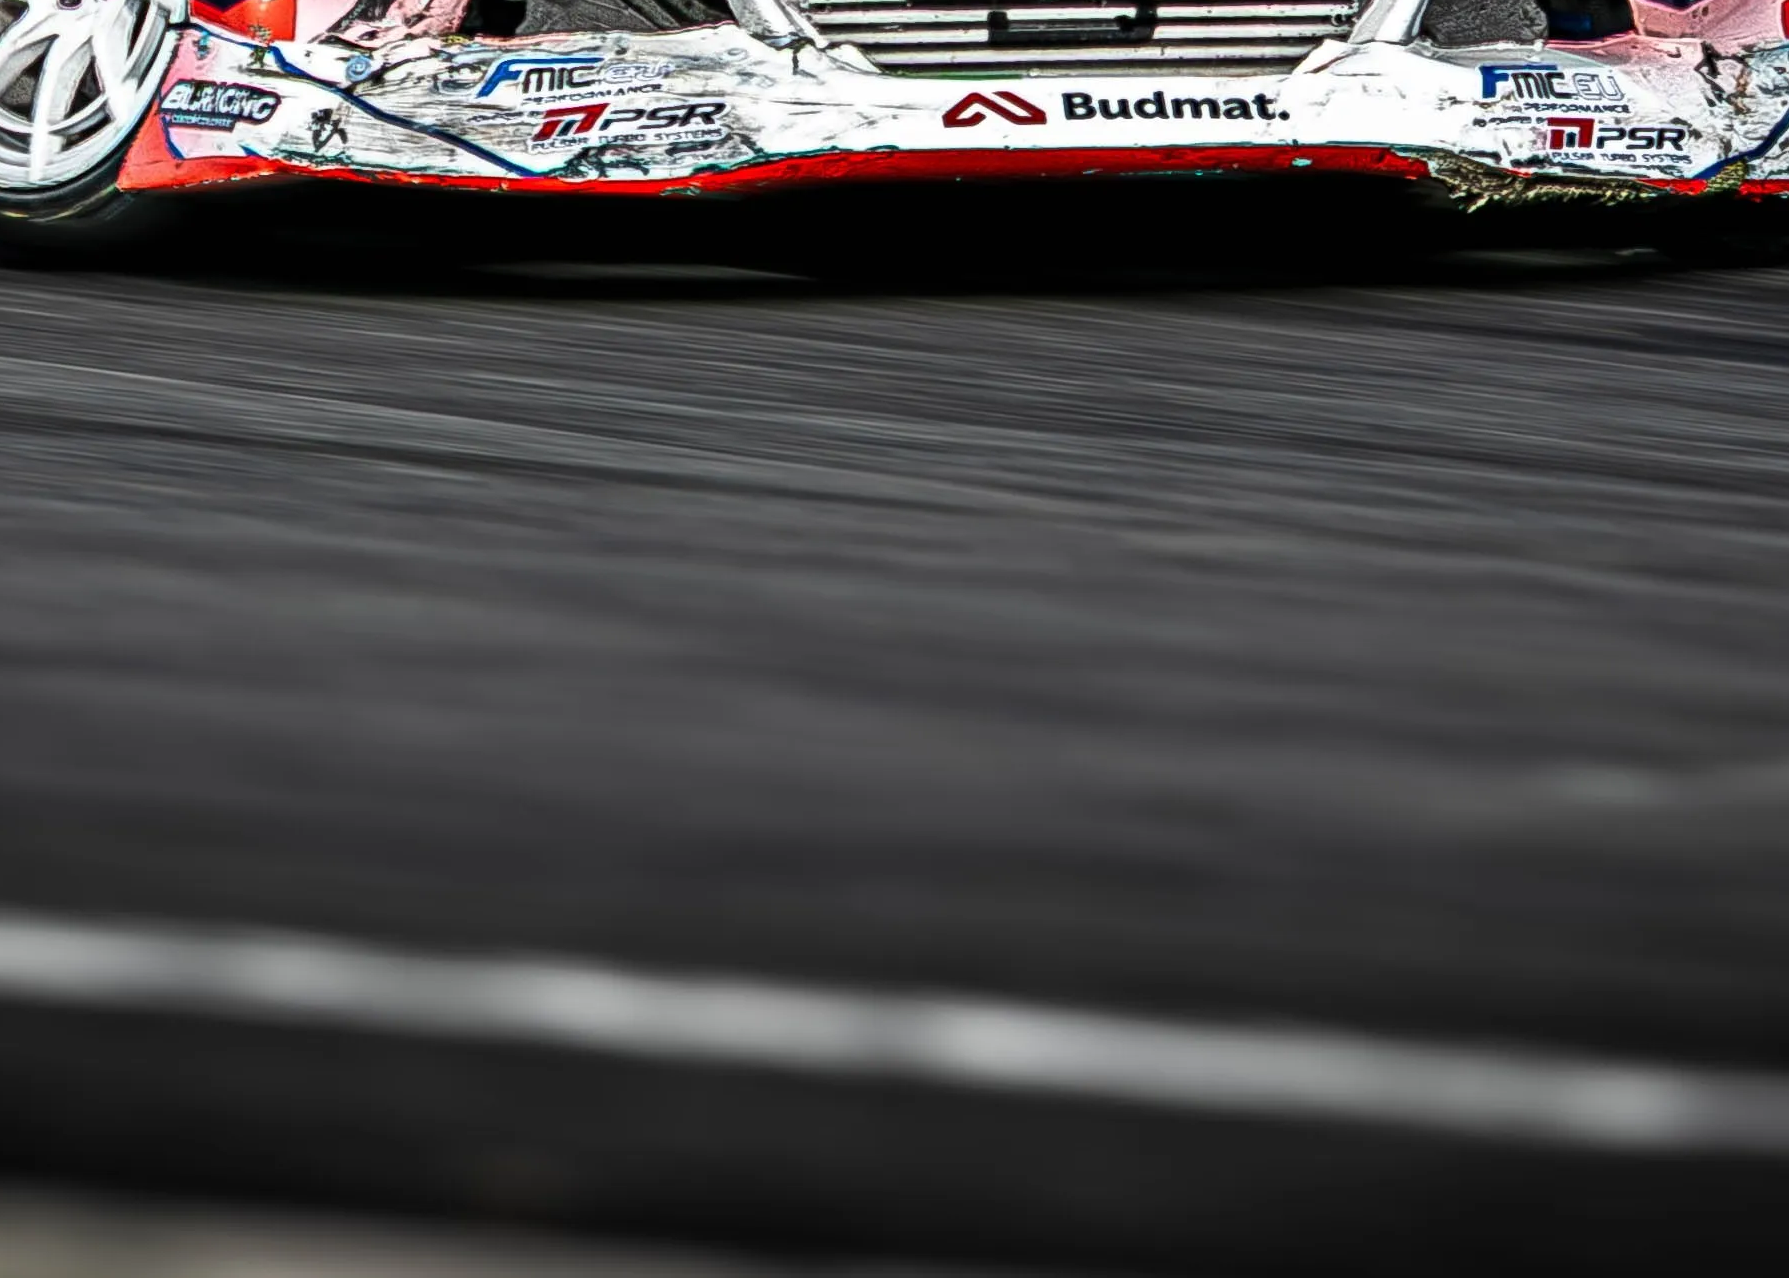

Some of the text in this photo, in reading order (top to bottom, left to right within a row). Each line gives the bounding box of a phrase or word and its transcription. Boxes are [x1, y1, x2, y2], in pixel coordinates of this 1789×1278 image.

[600, 103, 726, 130] PSR
[1062, 92, 1291, 122] Budmat.
[654, 128, 723, 141] SYSTEMS
[1597, 127, 1686, 151] PSR
